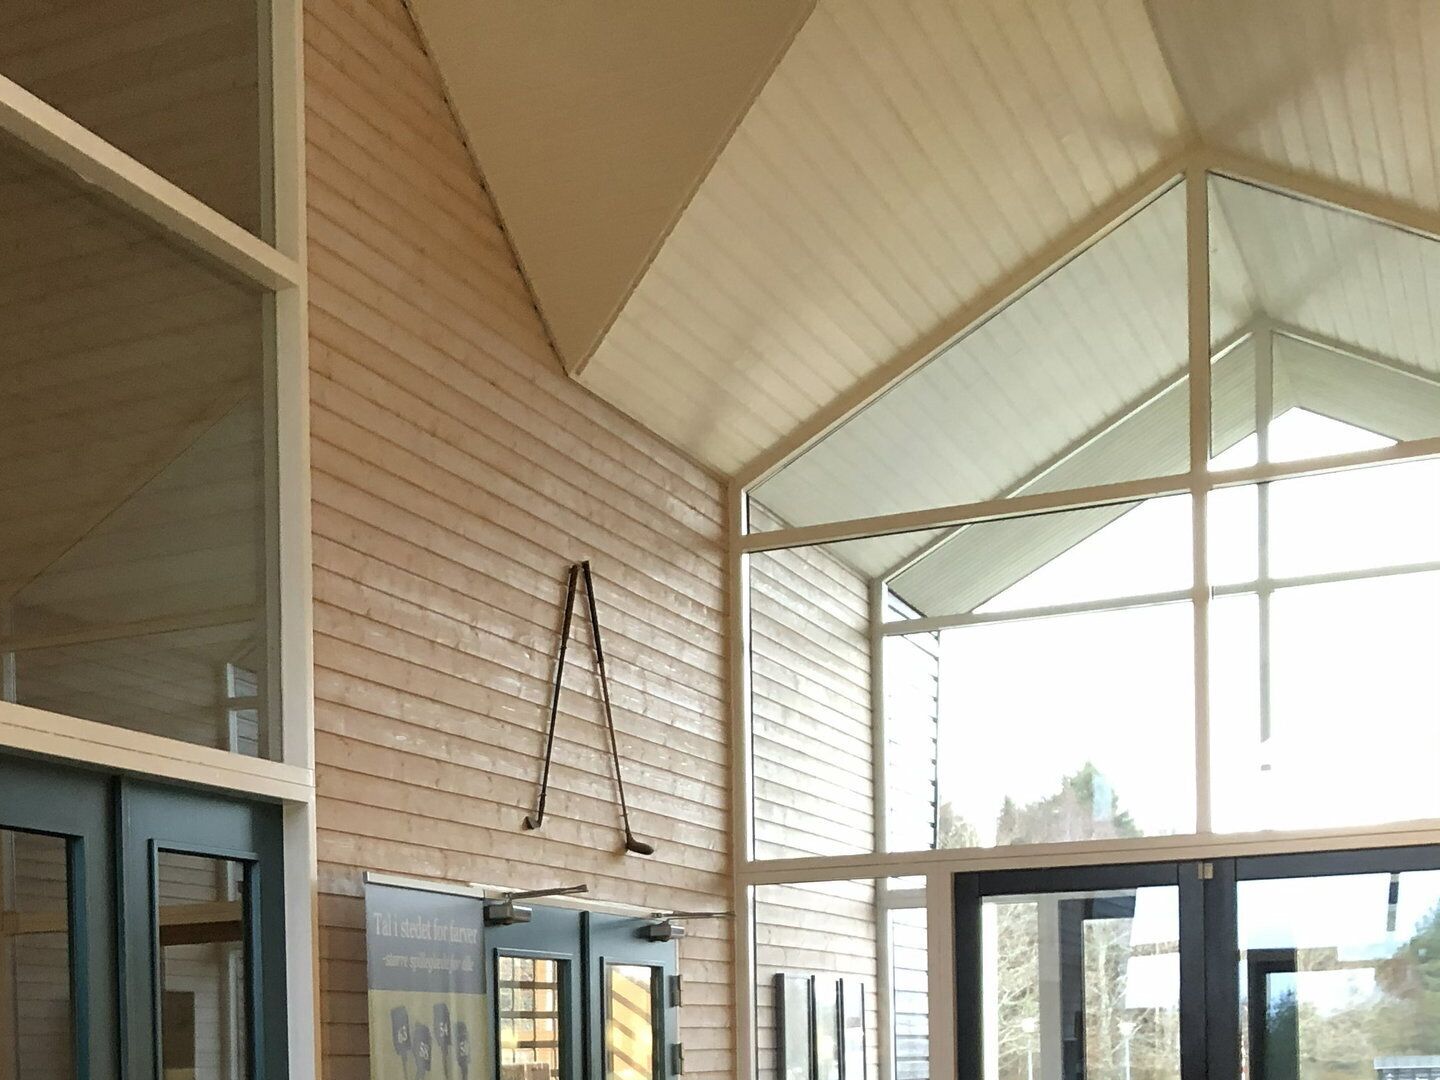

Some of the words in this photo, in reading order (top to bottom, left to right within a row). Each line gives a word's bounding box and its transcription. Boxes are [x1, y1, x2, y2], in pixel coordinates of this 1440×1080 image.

[373, 911, 392, 937] Tal
[401, 915, 432, 941] stedet
[433, 917, 448, 942] for
[449, 919, 478, 945] farver
